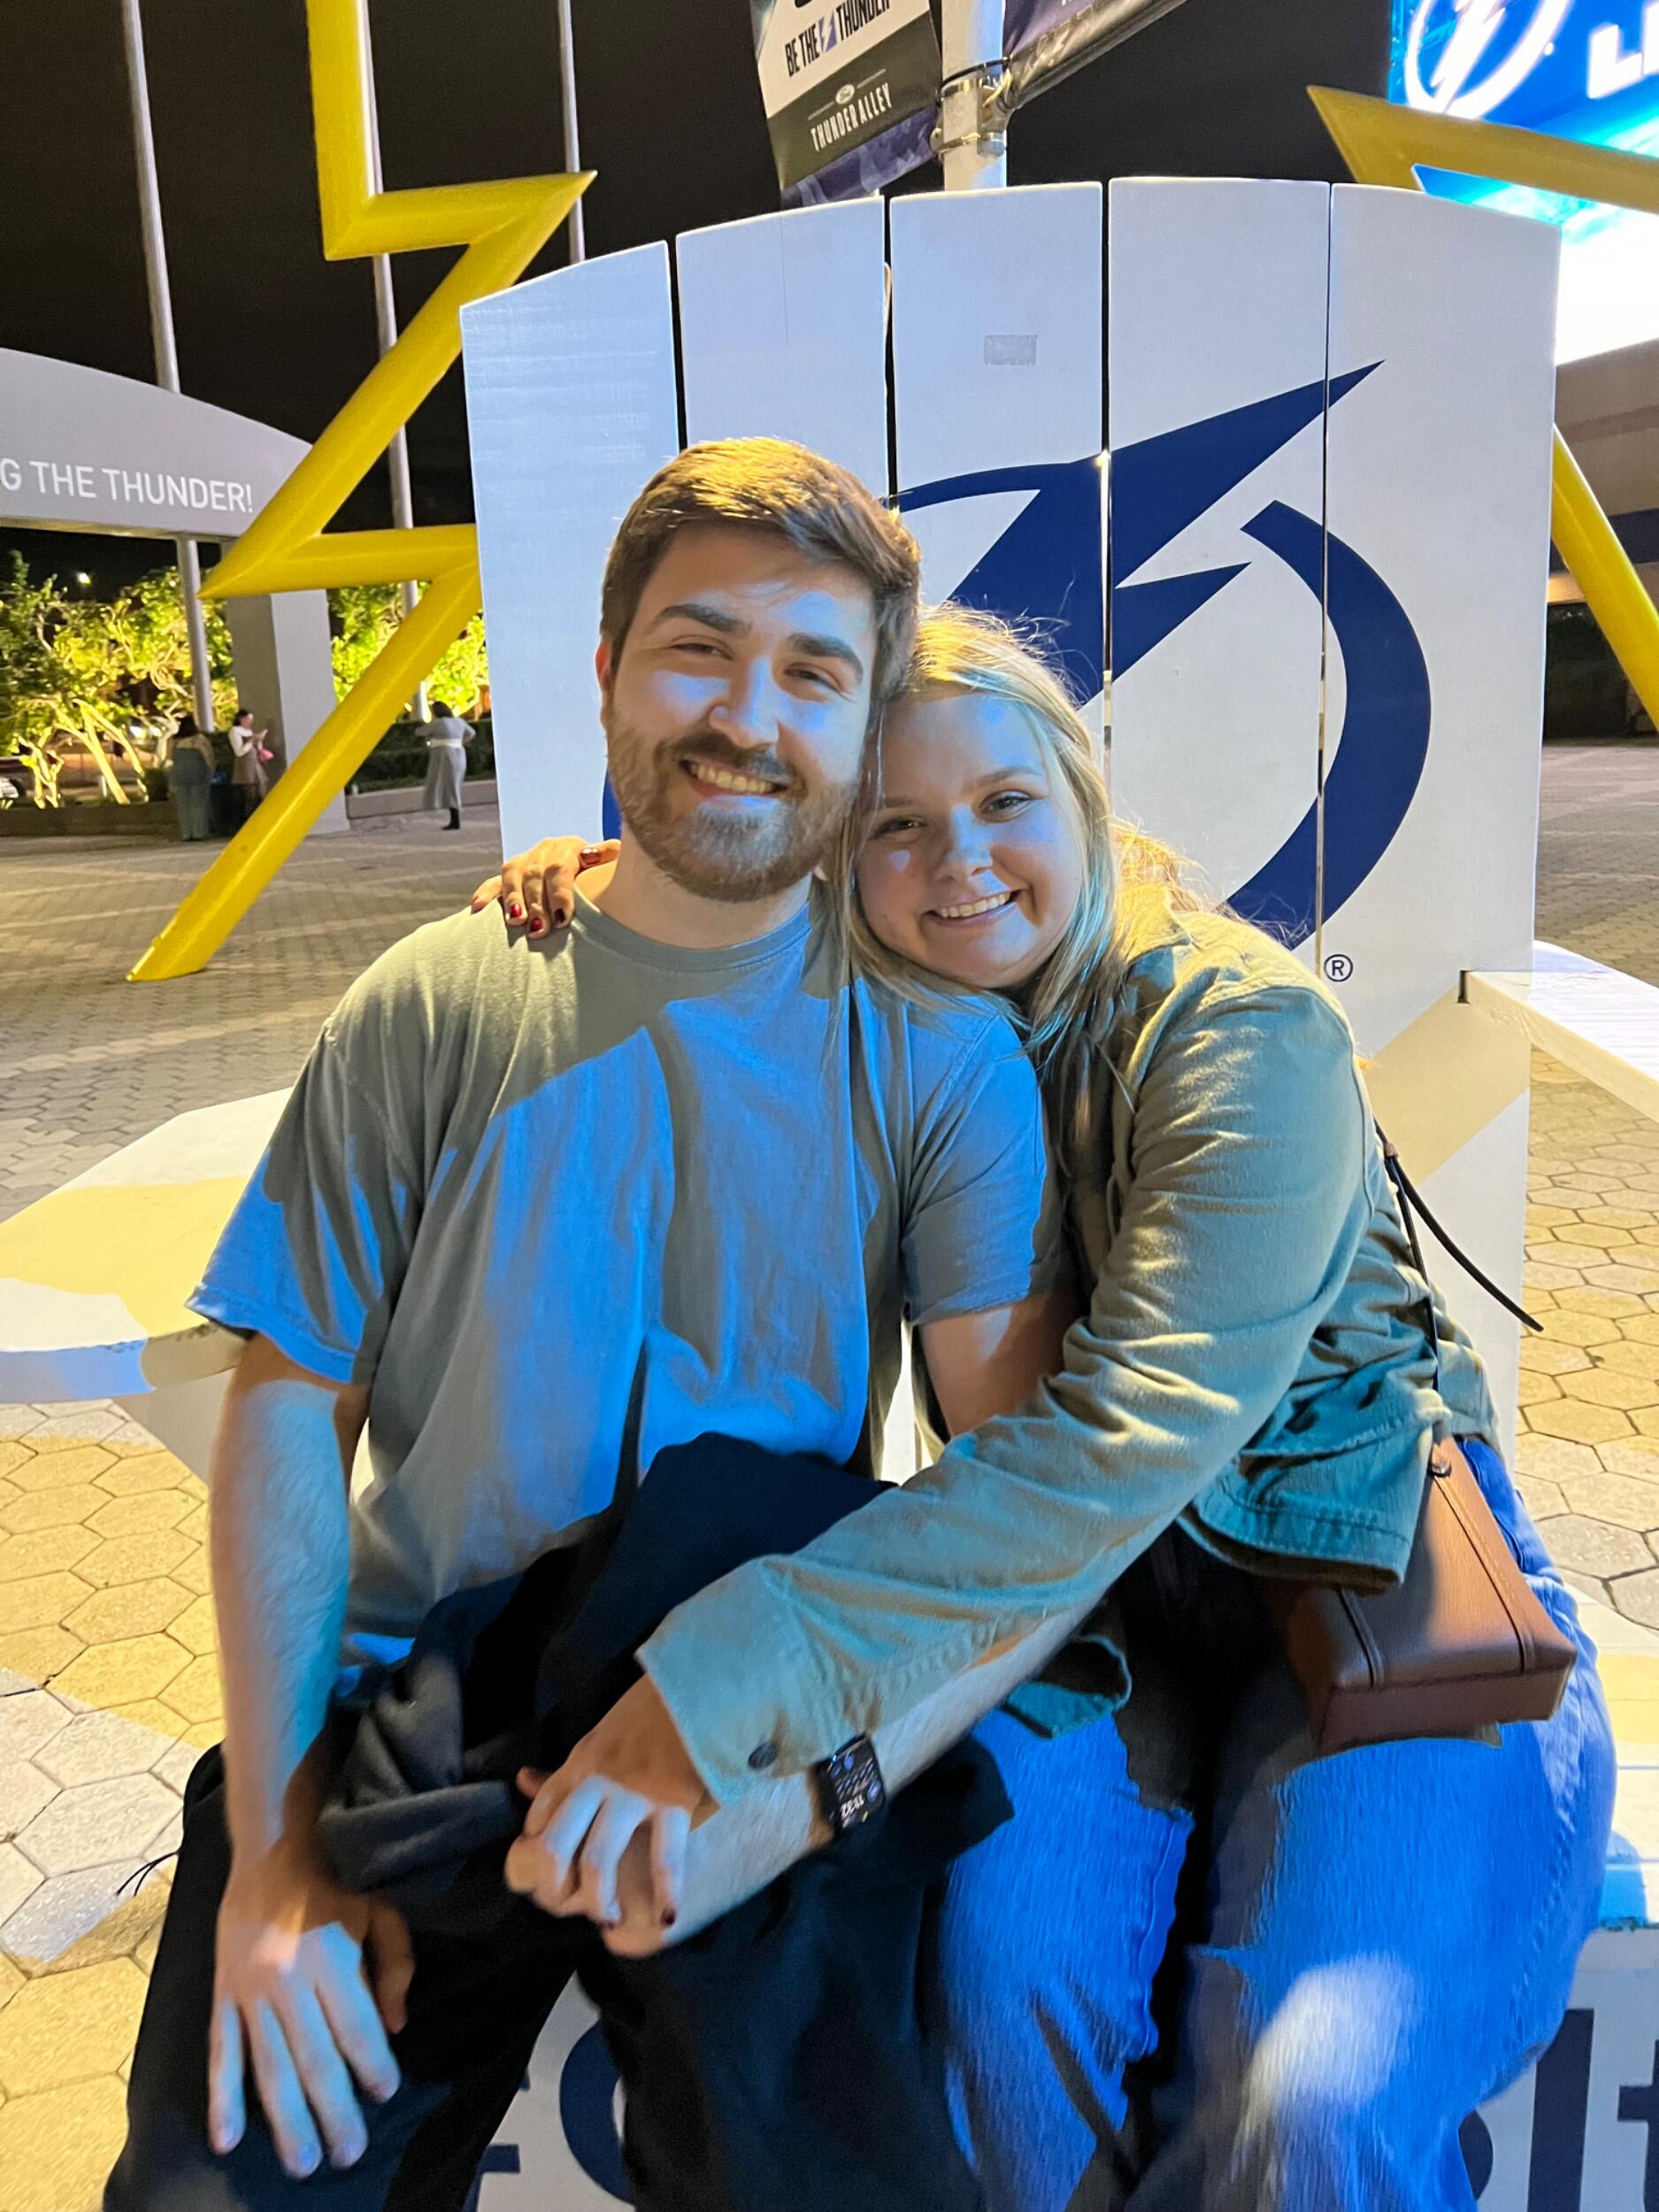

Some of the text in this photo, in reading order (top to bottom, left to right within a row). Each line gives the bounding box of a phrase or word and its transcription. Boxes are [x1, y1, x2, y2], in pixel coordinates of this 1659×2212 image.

[785, 38, 800, 77] BE
[798, 23, 820, 67] THE
[810, 82, 893, 152] THUNDER ALLEY
[29, 460, 97, 499] THE
[102, 468, 253, 513] THUNDER!
